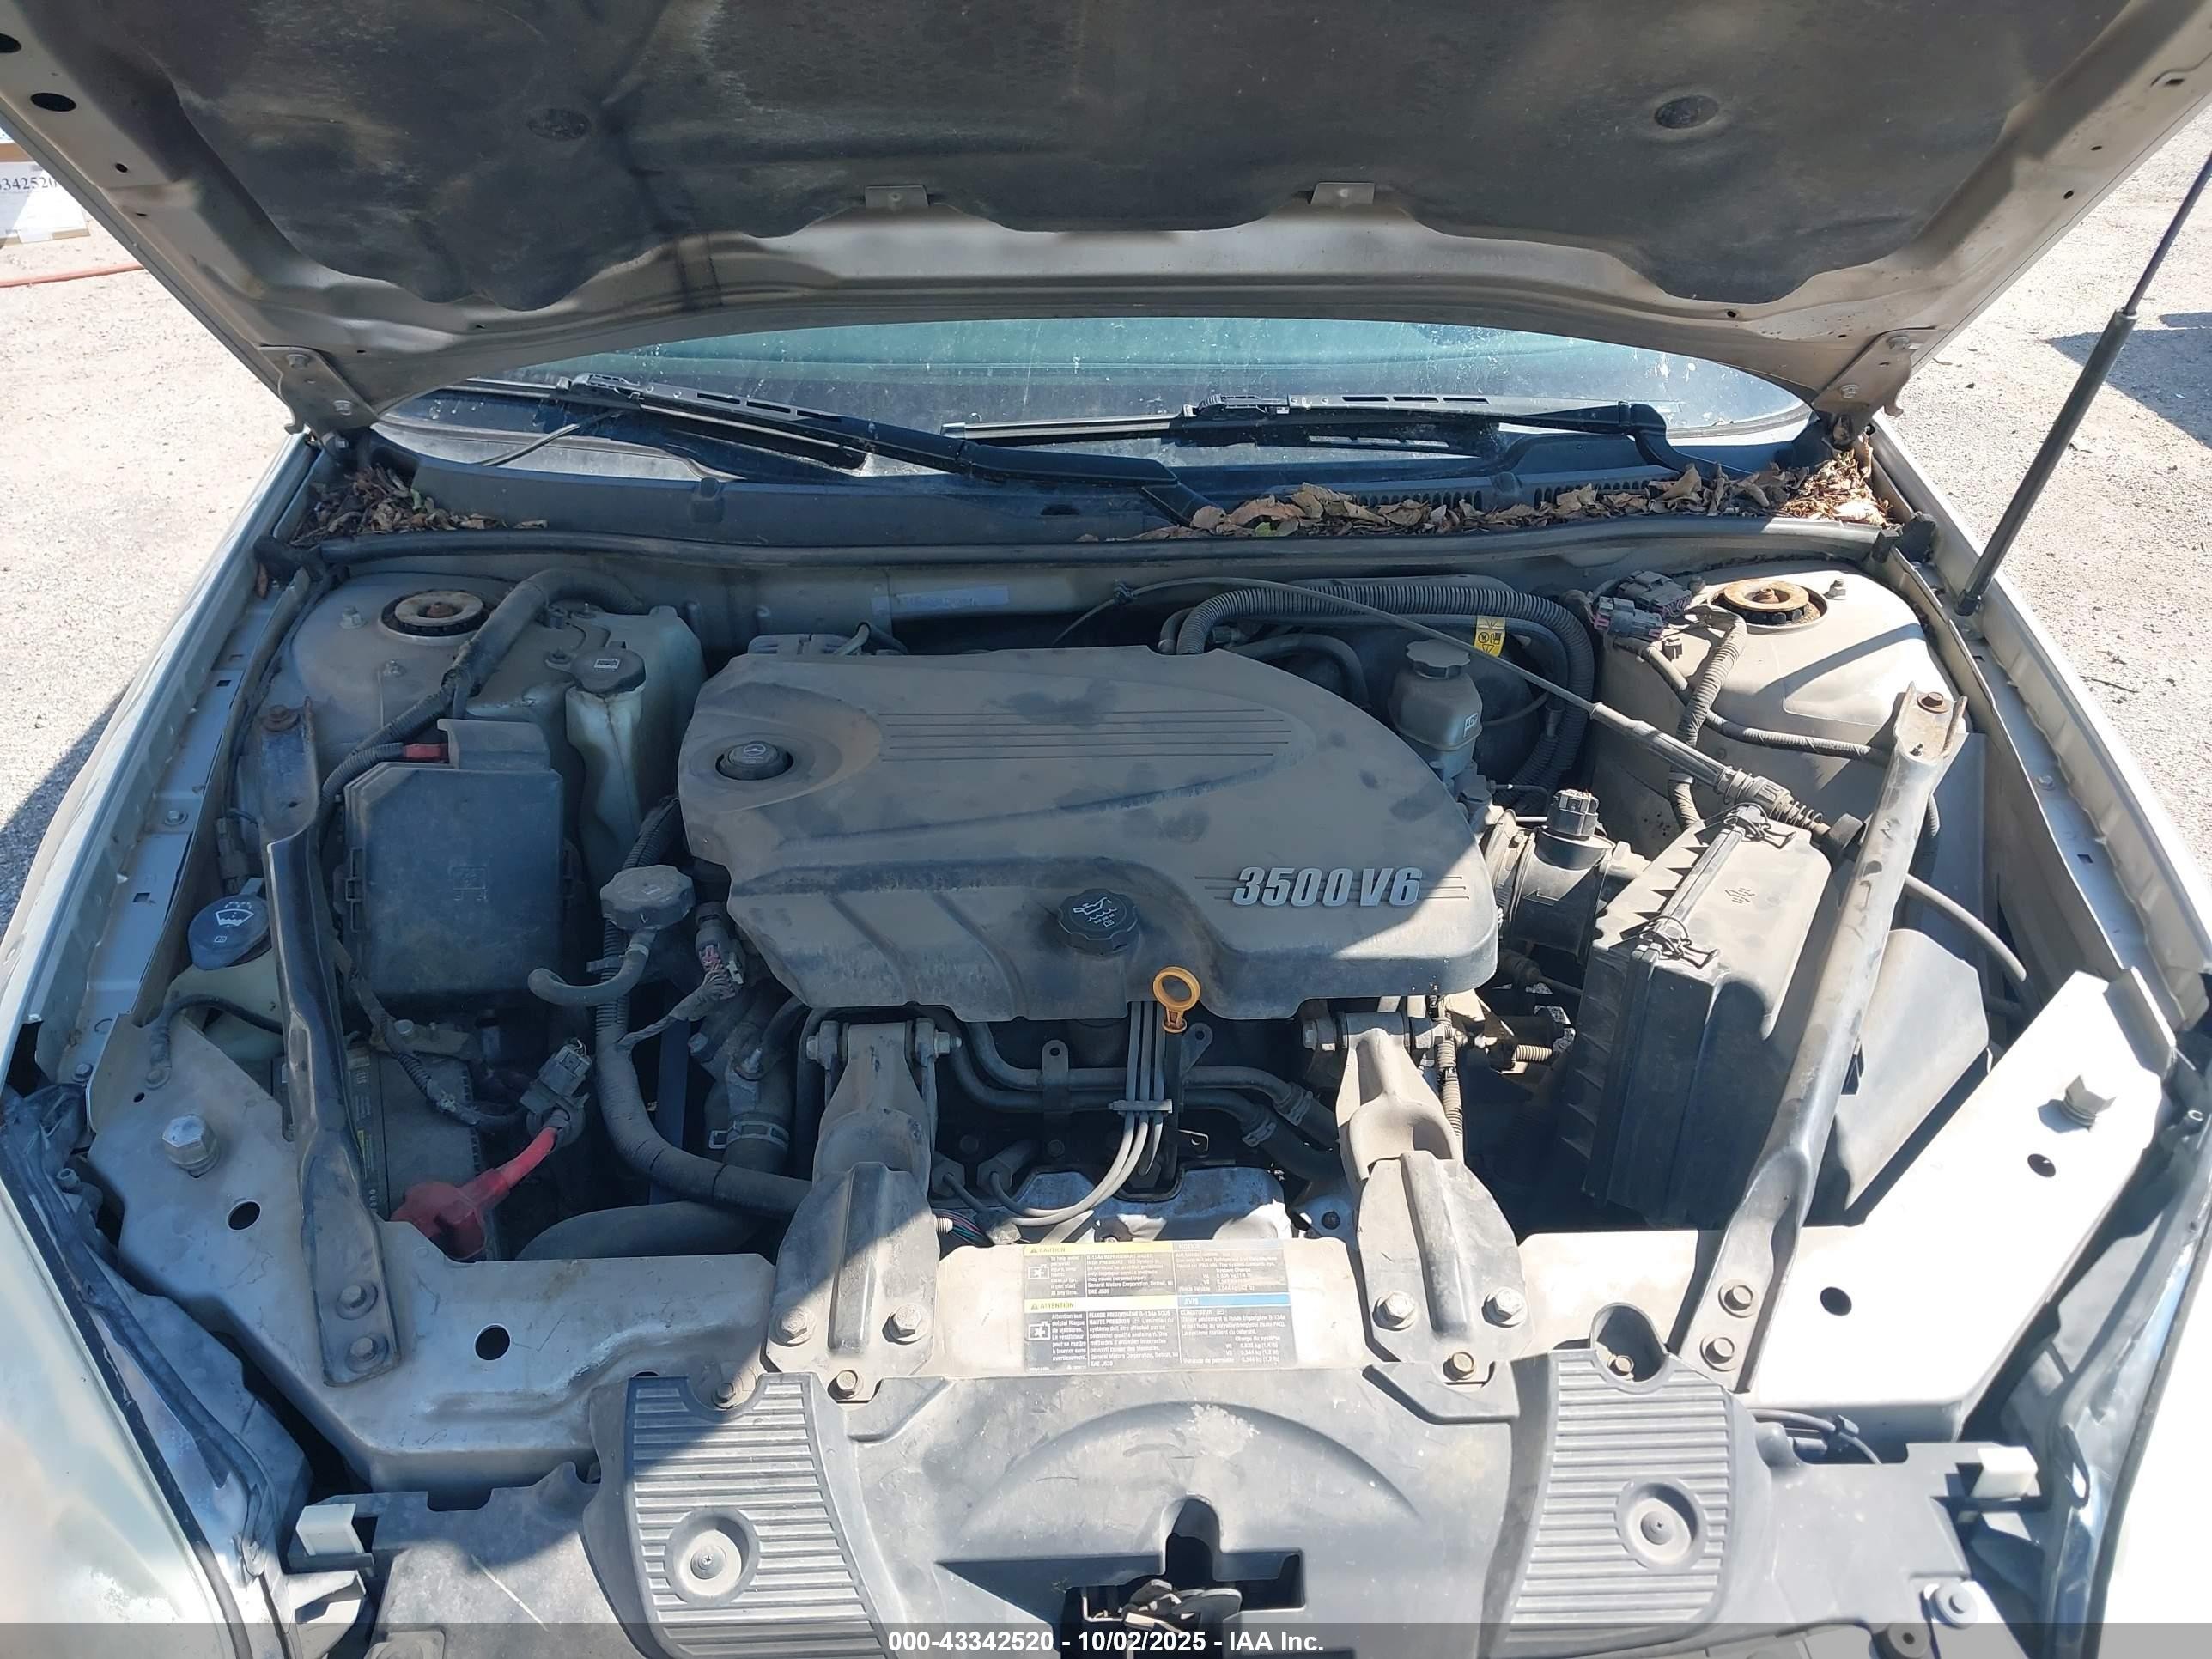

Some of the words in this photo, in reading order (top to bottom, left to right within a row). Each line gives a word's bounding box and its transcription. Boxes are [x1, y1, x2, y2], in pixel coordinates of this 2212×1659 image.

[0, 177, 58, 191] 342520
[1233, 867, 1353, 906] 3500
[1360, 868, 1422, 906] V6
